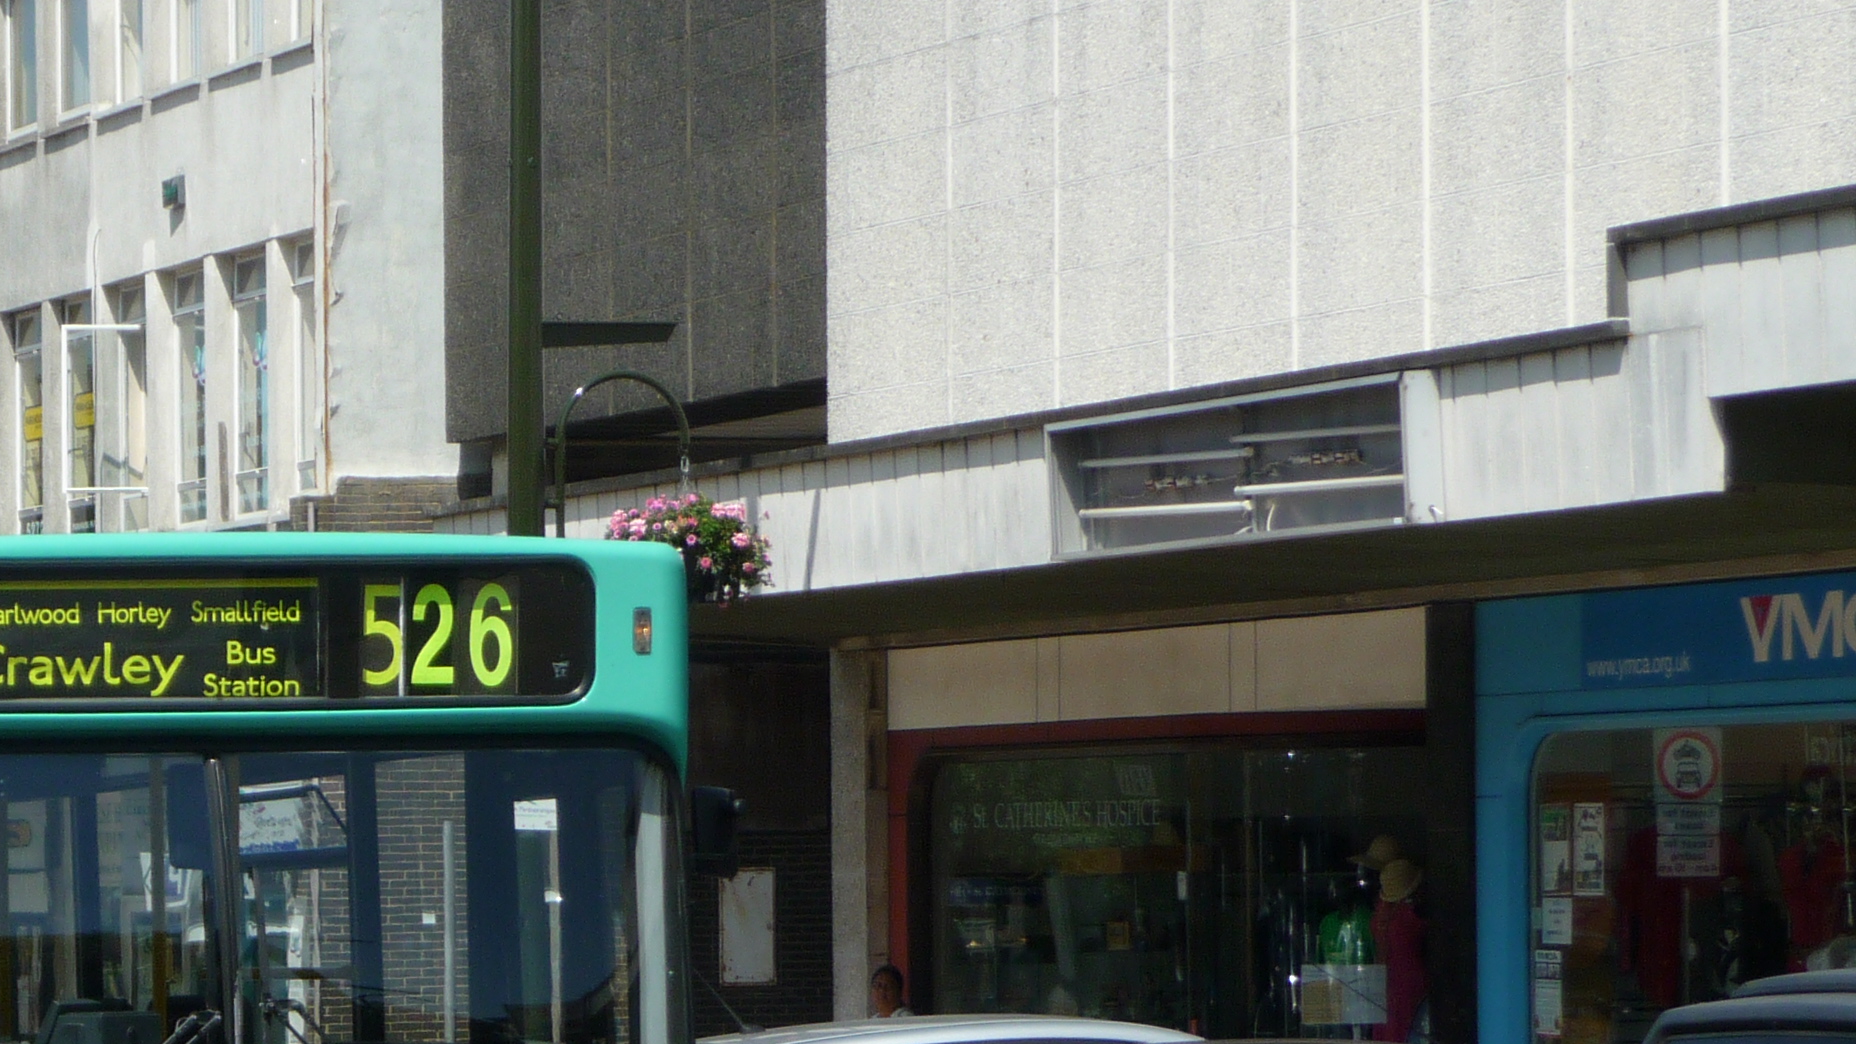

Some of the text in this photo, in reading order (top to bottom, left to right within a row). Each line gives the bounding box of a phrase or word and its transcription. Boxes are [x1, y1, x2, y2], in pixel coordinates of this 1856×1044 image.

[98, 601, 172, 629] Horley
[191, 600, 301, 623] Smallfield
[1740, 590, 1856, 663] YM
[362, 583, 513, 687] 526
[227, 640, 276, 665] Bus
[1587, 652, 1691, 679] www.ymca.org.uk
[203, 674, 300, 698] Station
[1097, 799, 1160, 827] HOSPICE
